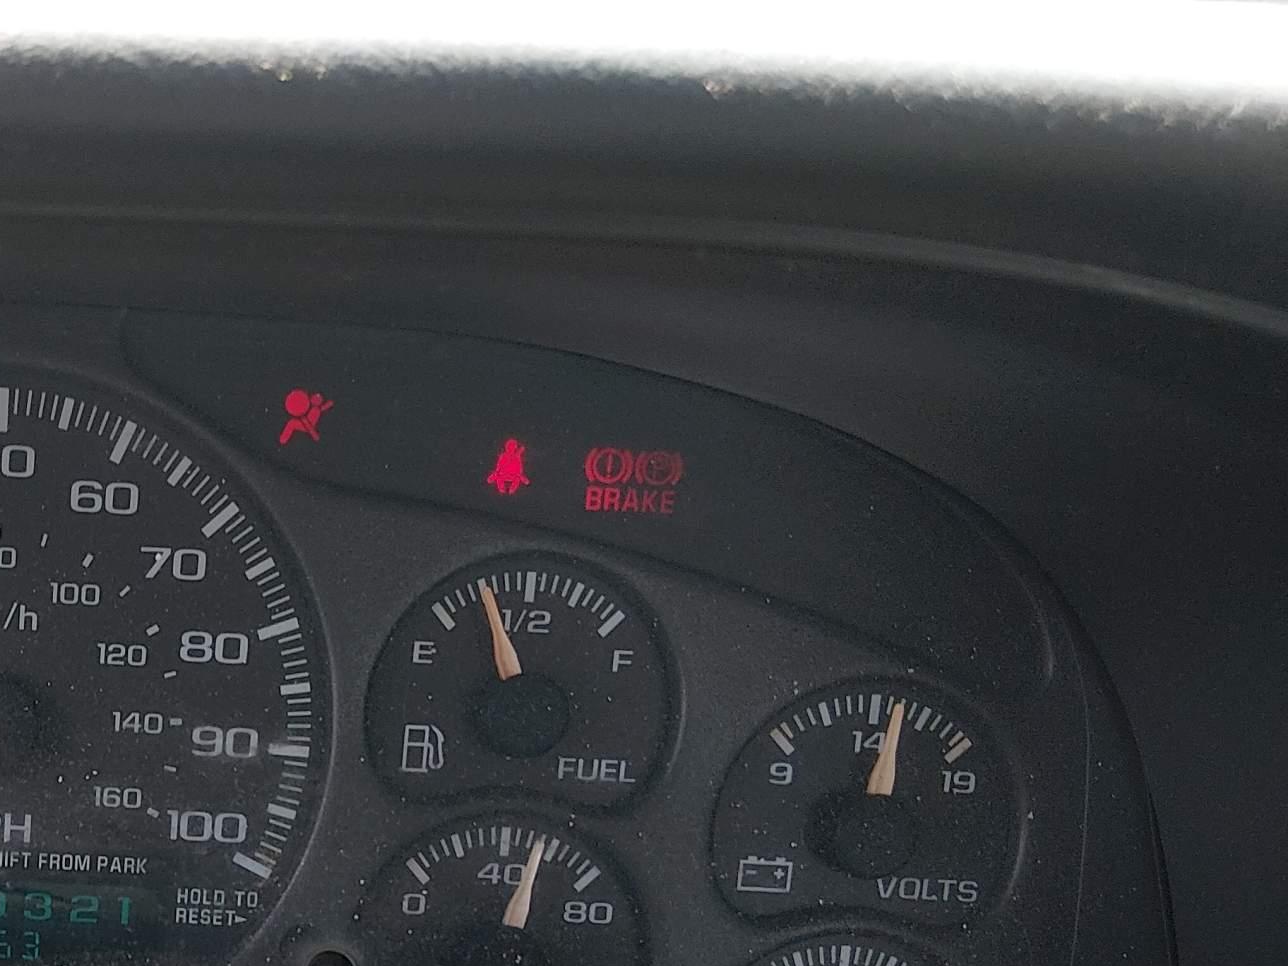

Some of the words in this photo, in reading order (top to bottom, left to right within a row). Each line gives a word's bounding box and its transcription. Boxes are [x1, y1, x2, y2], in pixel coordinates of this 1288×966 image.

[70, 482, 139, 514] 60
[585, 486, 675, 513] BRAKE
[140, 546, 207, 581] 70
[50, 582, 101, 606] 100
[501, 609, 552, 634] 1/2
[97, 643, 147, 667] 120
[179, 632, 248, 665] 80
[412, 640, 437, 664] E
[612, 649, 634, 672] F
[112, 712, 164, 734] 140
[191, 726, 258, 758] 90
[852, 730, 886, 753] 14
[557, 757, 636, 784] FUEL
[769, 762, 792, 785] 9
[941, 770, 977, 794] 19
[94, 787, 142, 809] 160
[167, 810, 249, 844] 100
[38, 852, 90, 872] FROM
[97, 855, 147, 875] PARK
[477, 863, 523, 886] 40
[177, 888, 226, 906] HOLD
[235, 891, 259, 908] TO
[875, 877, 978, 903] VOLTS
[23, 892, 52, 922] 3
[69, 895, 99, 924] 2
[118, 898, 131, 925] 1
[402, 893, 426, 915] 0
[563, 902, 614, 925] 80
[175, 908, 234, 926] RESET
